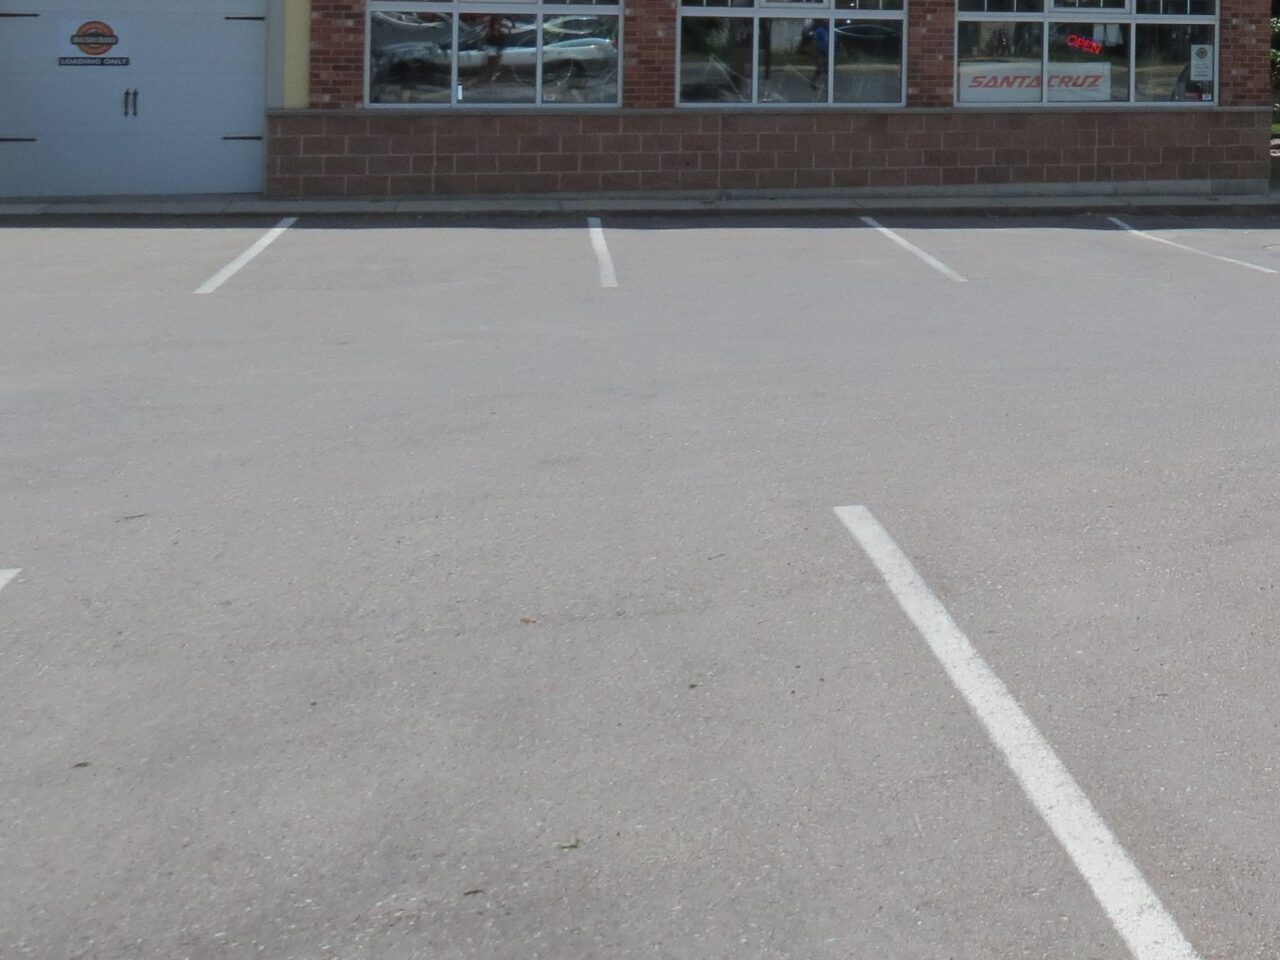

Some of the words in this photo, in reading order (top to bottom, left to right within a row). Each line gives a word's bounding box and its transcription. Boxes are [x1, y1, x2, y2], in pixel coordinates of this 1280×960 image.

[1066, 34, 1103, 55] OPEN
[968, 75, 1043, 88] SANTA
[1046, 75, 1104, 89] CRUZ
